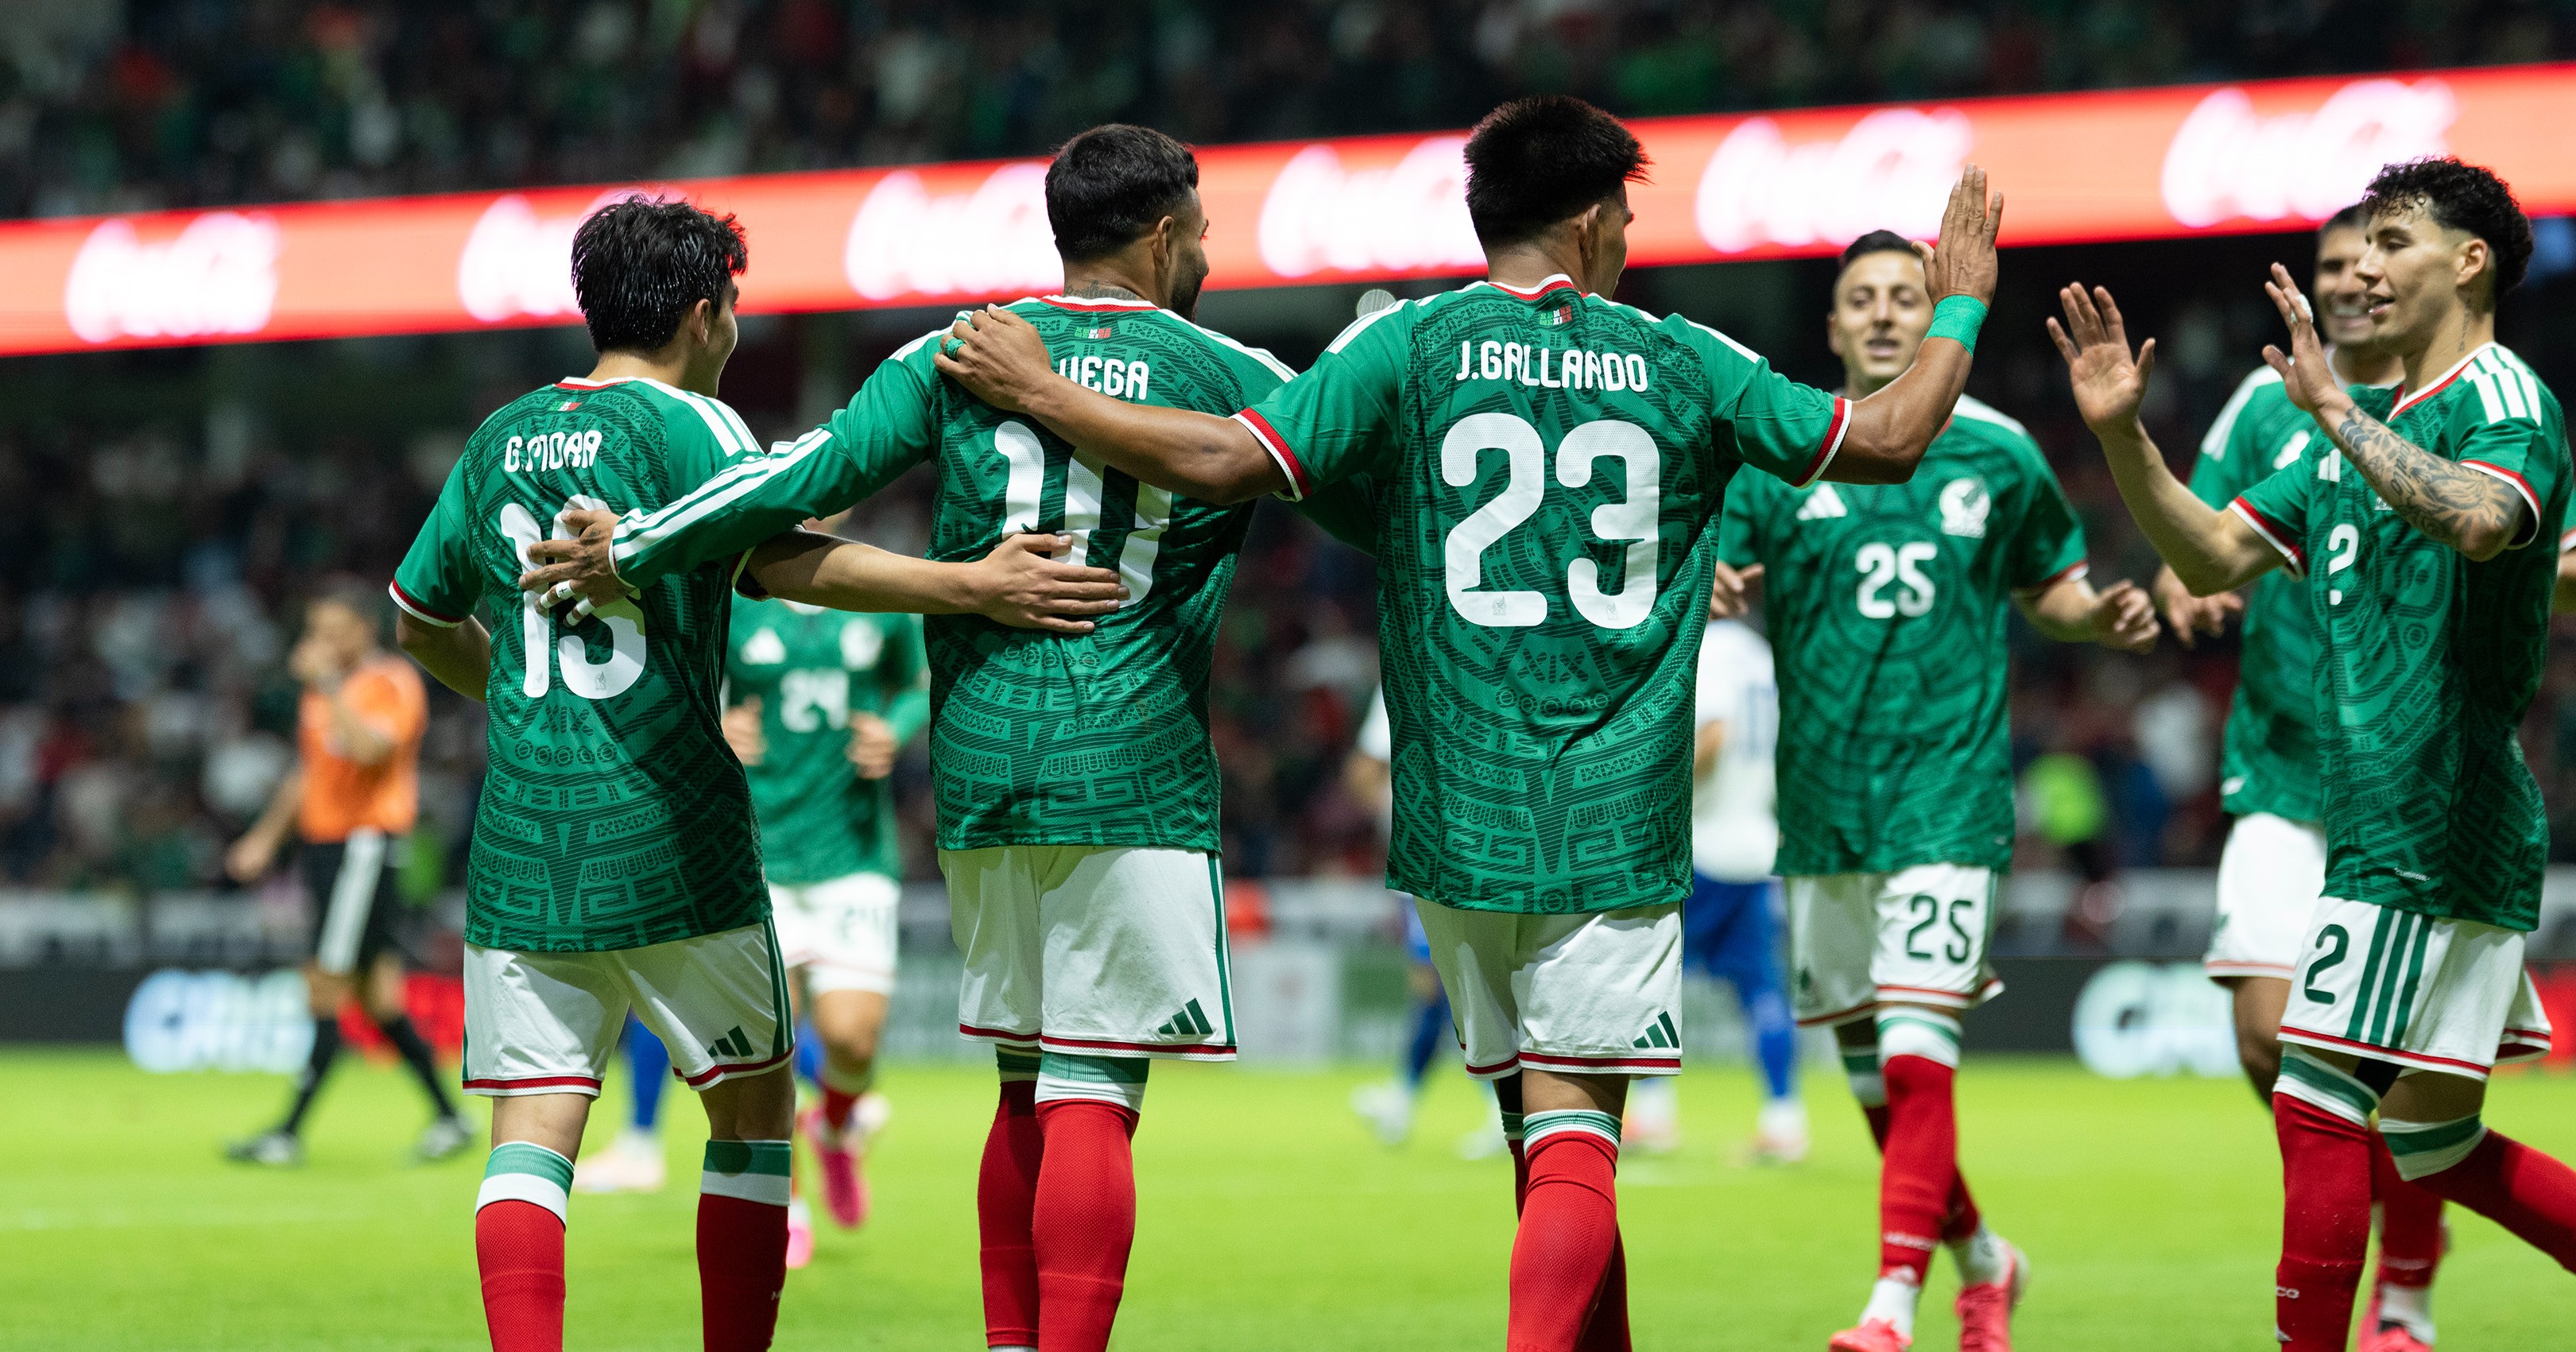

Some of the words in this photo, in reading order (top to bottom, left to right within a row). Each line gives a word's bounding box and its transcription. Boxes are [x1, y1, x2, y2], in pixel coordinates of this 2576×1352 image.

[1455, 340, 1648, 393] J.GALLARDO
[504, 430, 602, 472] G.MORA
[1441, 413, 1660, 630] 23
[1855, 541, 1938, 619] 25
[1906, 894, 1975, 964] 25
[2304, 923, 2350, 1005] 2
